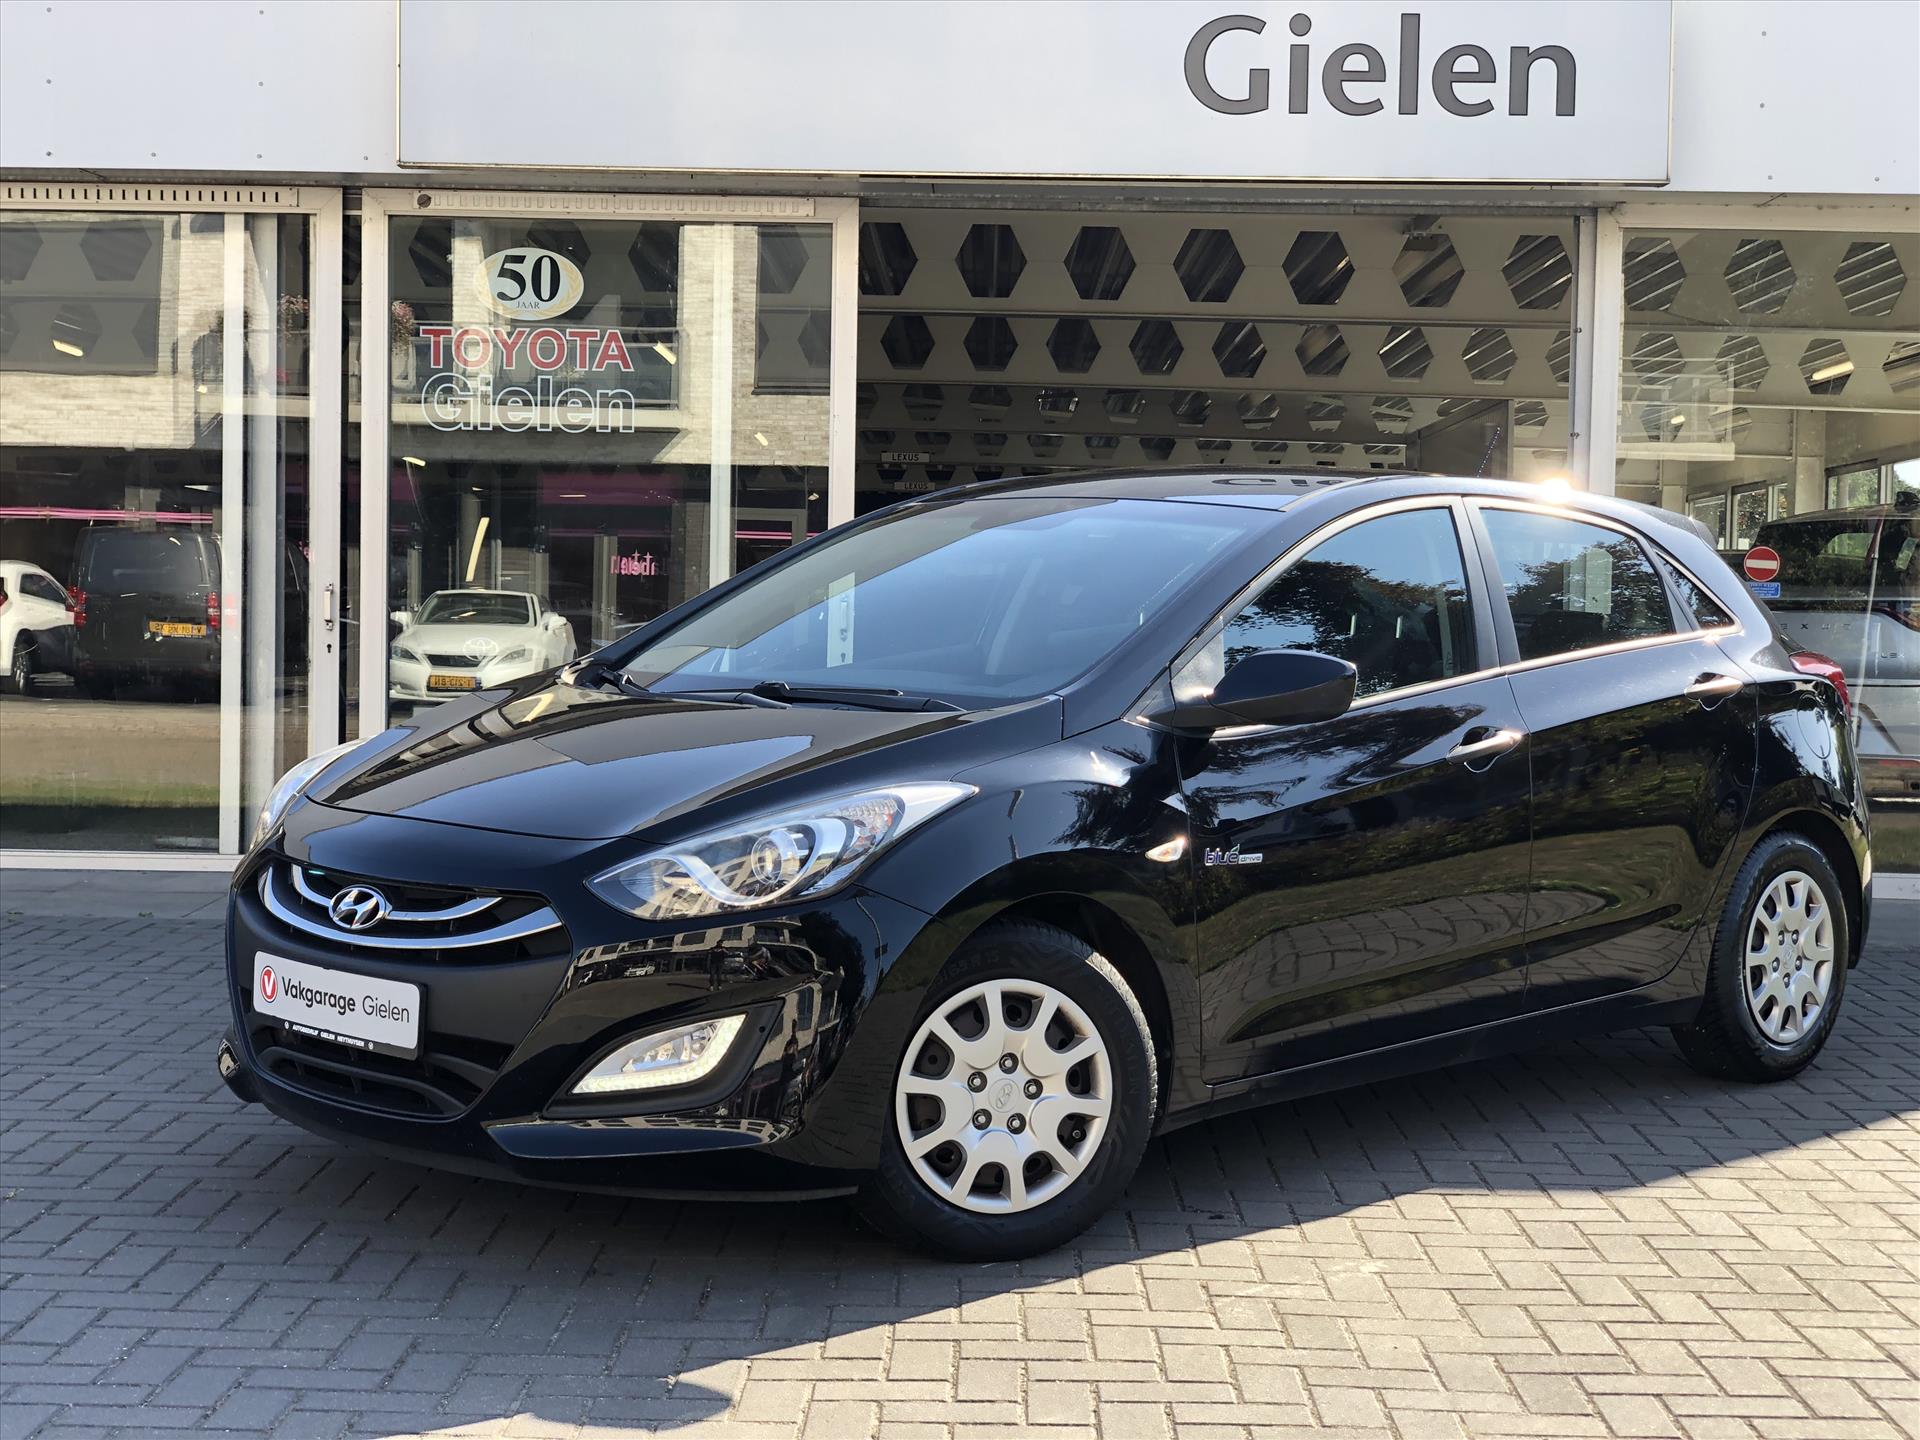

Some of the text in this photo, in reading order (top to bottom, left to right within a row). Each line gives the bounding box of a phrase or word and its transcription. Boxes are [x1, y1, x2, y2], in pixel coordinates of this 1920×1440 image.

[1184, 13, 1576, 117] Gielen
[496, 254, 561, 302] 50
[515, 301, 540, 310] JAAR
[420, 326, 635, 371] TOYOTA
[421, 373, 635, 433] Gielen
[892, 453, 919, 461] LEXUS
[904, 482, 928, 490] LEXUS
[282, 976, 356, 1015] Vakgarage
[362, 995, 409, 1023] Gielen
